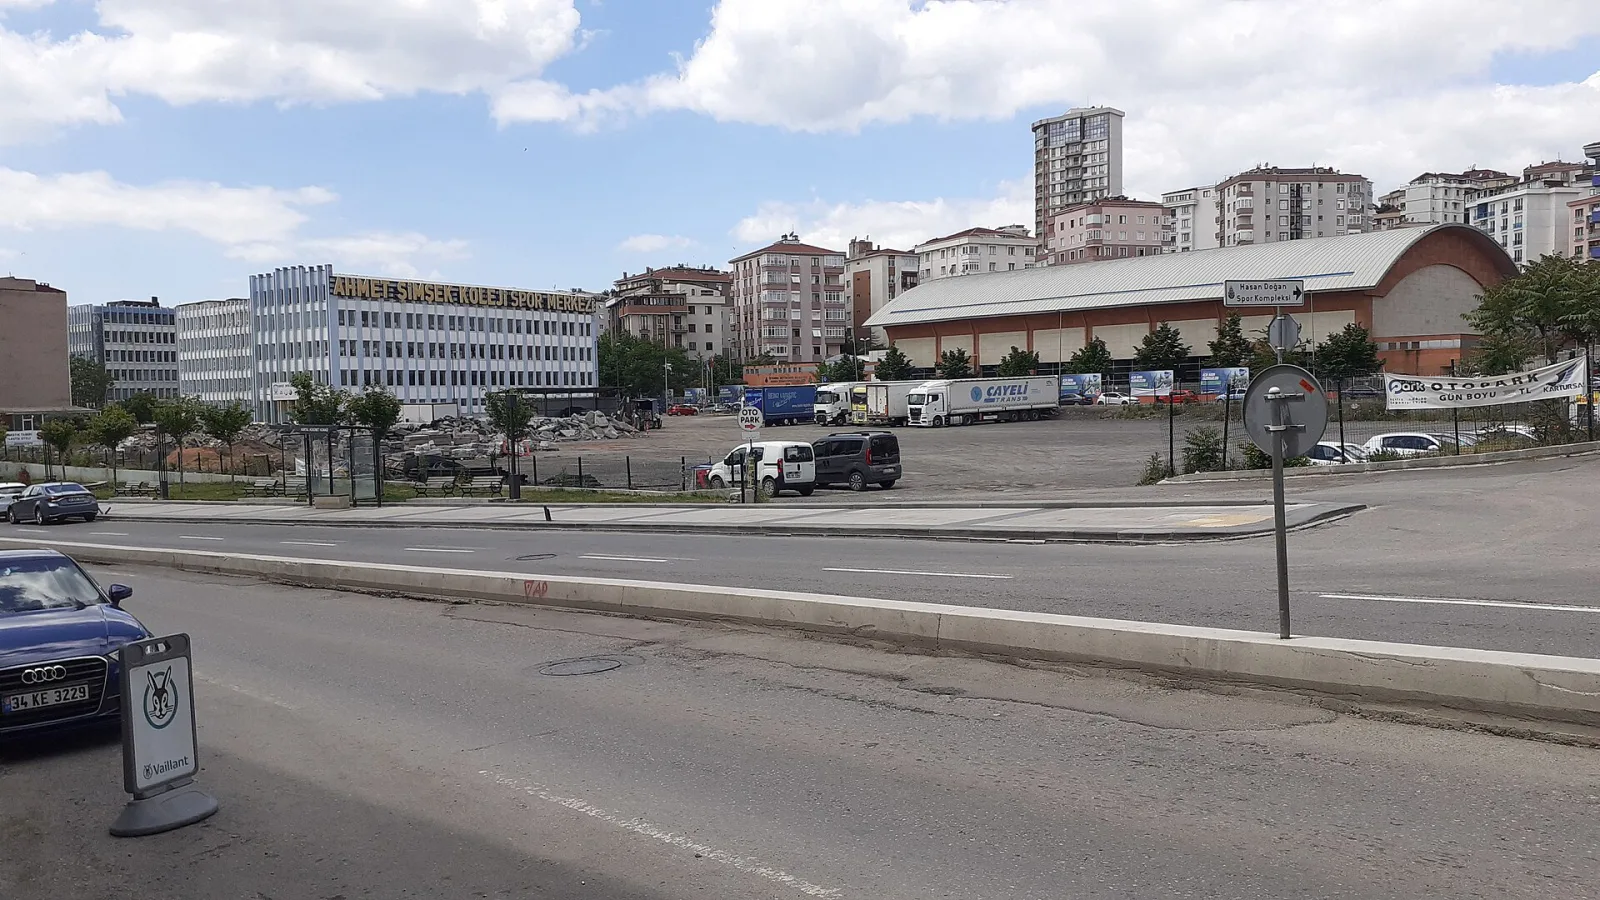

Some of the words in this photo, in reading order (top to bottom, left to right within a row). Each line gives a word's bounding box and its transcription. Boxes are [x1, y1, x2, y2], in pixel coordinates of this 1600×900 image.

[333, 276, 388, 299] AHMET
[397, 281, 453, 303] ŞİMŞEK
[459, 286, 507, 306] KOLEJİ
[511, 292, 543, 309] SPOR
[547, 296, 596, 313] MERKEZİ
[1264, 283, 1287, 291] Doğan
[1237, 295, 1253, 303] Spor
[1431, 373, 1539, 391] OTOPARK
[1439, 393, 1462, 401] GÜN
[1467, 391, 1496, 400] BOYU
[12, 696, 28, 709] 34
[32, 692, 48, 706] KE
[54, 686, 86, 702] 3229
[152, 755, 189, 776] Vaillant
